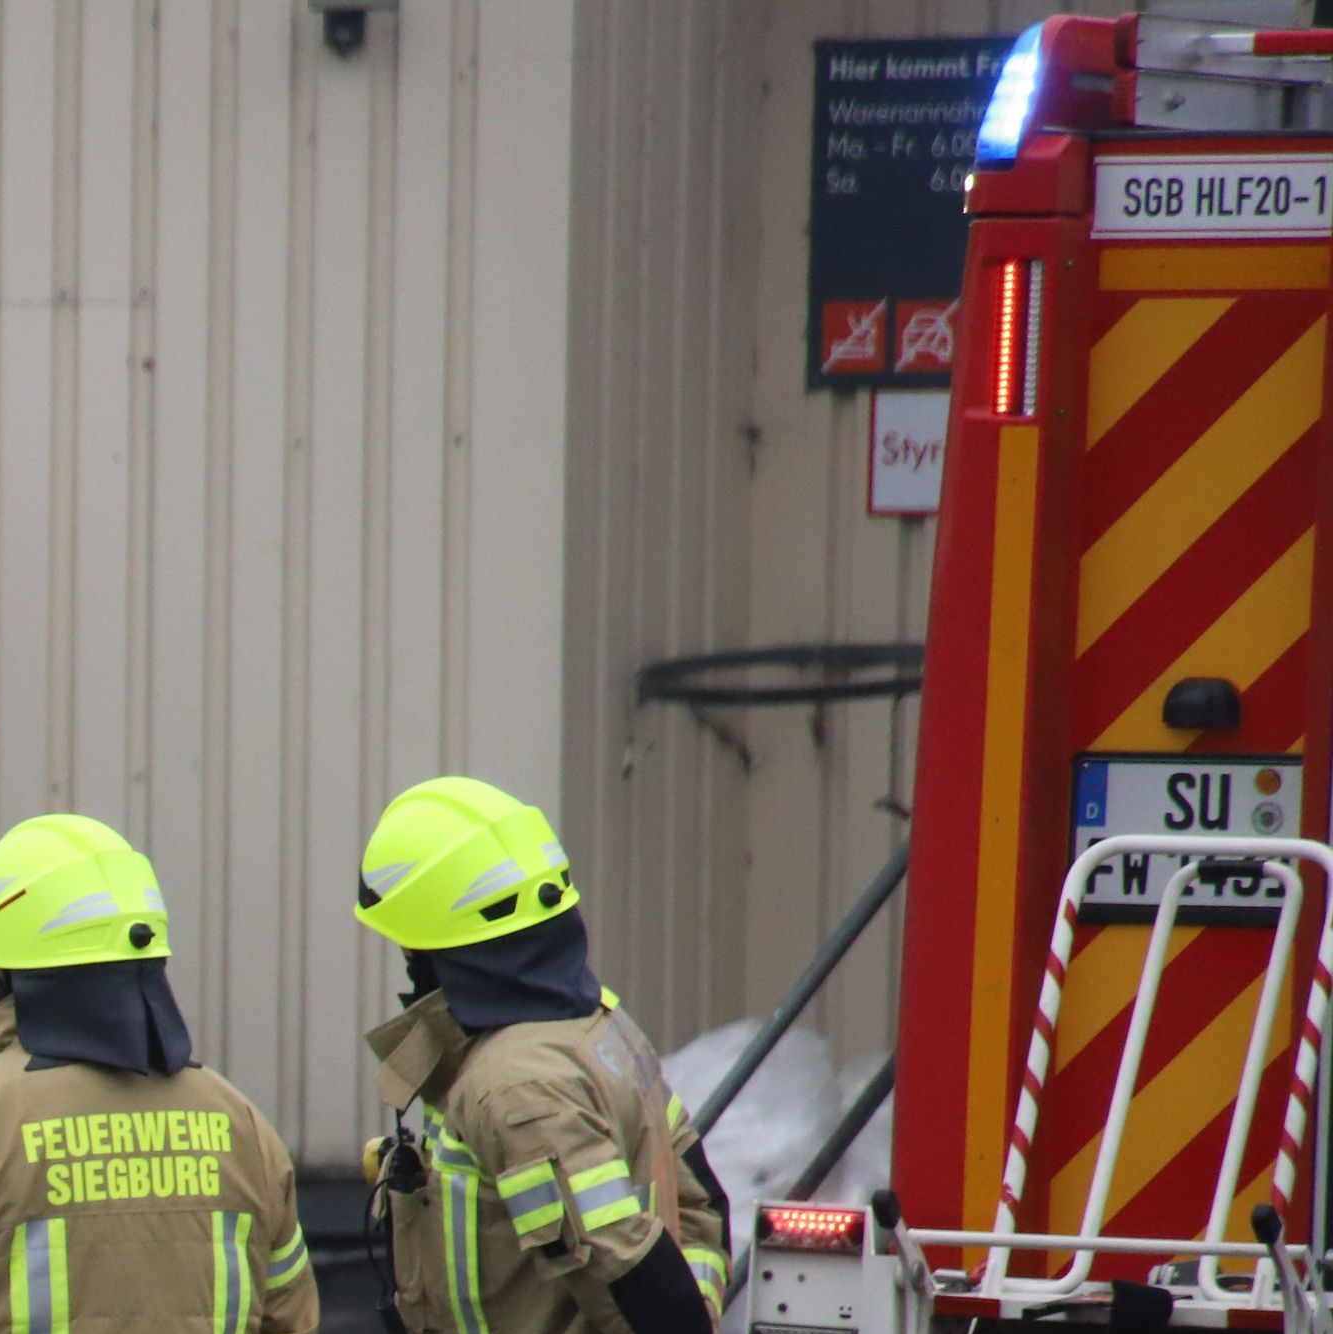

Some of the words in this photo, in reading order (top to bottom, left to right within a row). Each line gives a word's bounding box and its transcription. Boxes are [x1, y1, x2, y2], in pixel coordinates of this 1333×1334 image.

[829, 53, 880, 80] Hier
[886, 52, 970, 79] kommt
[1123, 176, 1184, 218] SGB
[1195, 173, 1327, 217] HLF20-1
[1085, 802, 1099, 820] D
[1163, 772, 1232, 831] SU
[21, 1110, 232, 1163] FEUERWEHR
[46, 1155, 221, 1206] SIEGBURG
